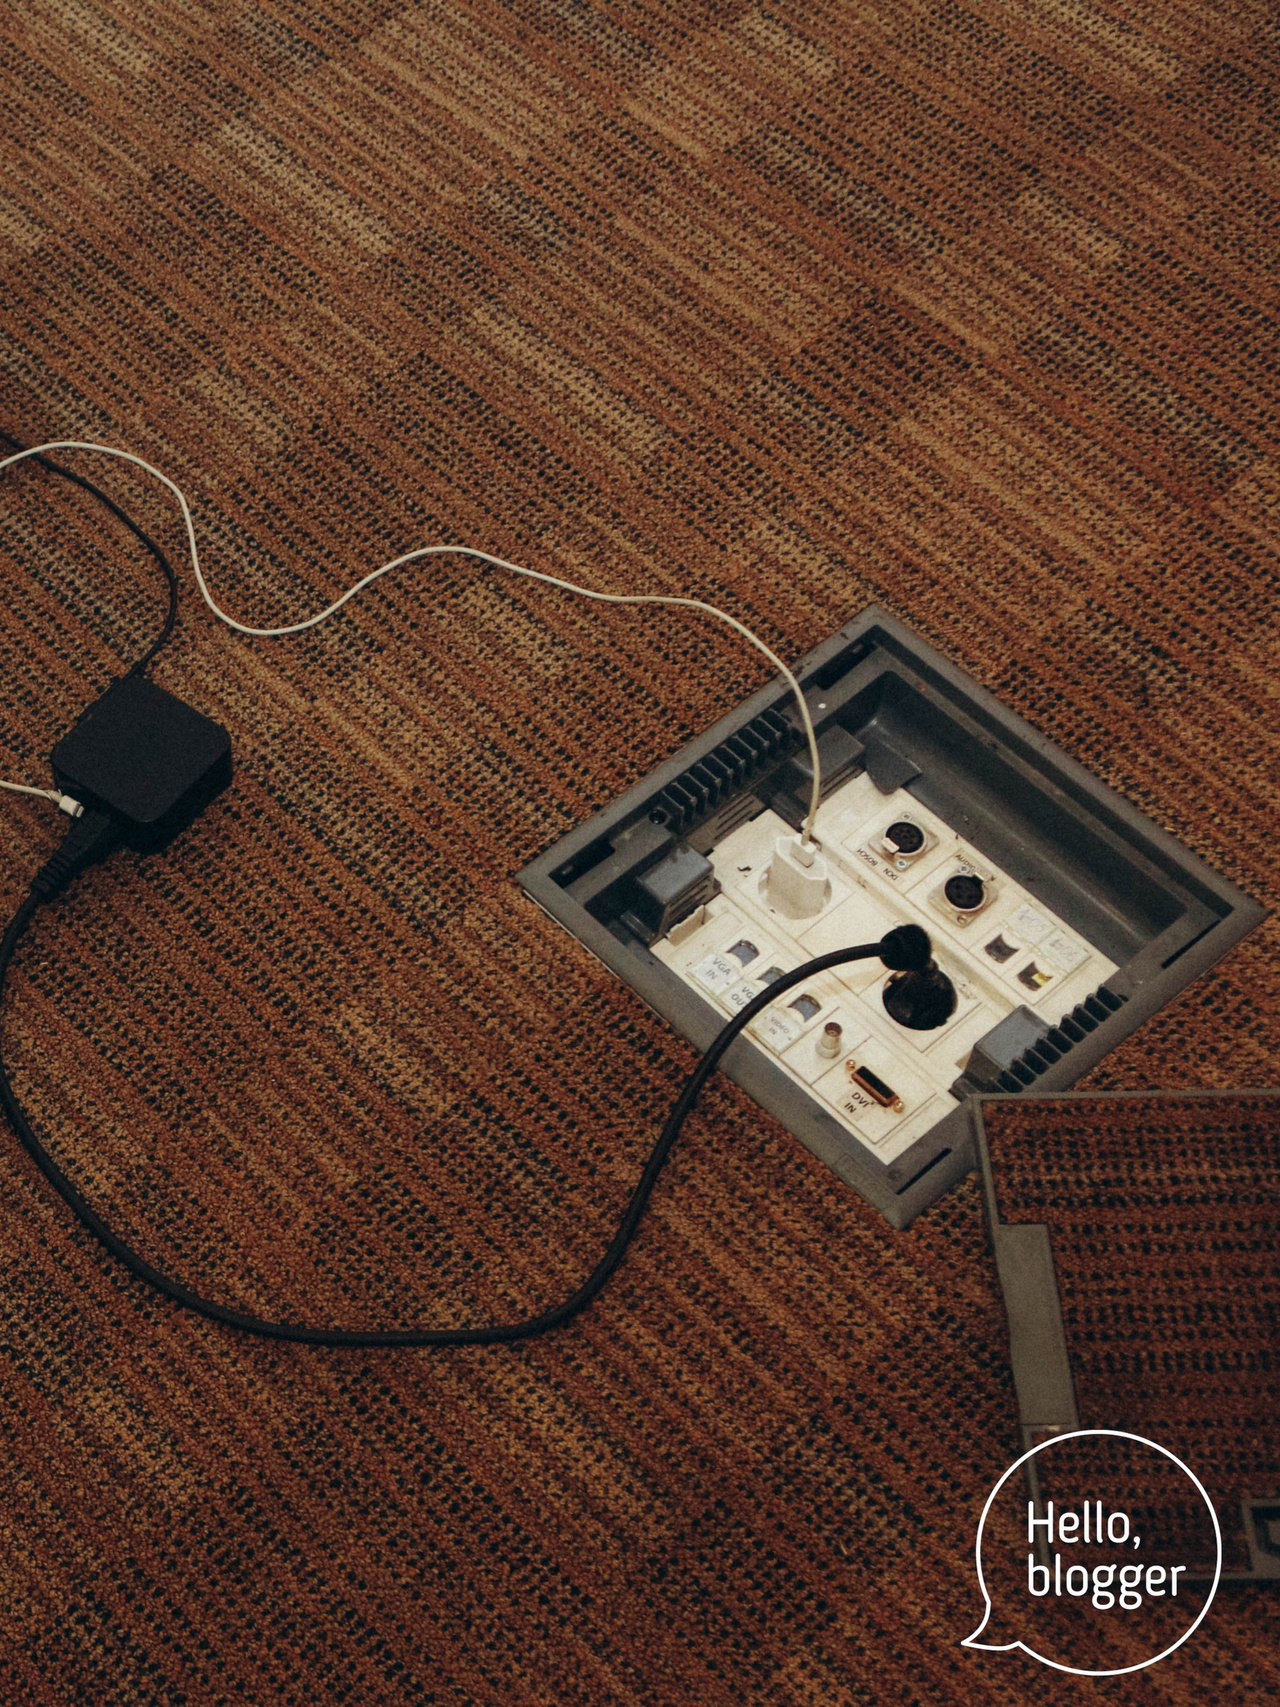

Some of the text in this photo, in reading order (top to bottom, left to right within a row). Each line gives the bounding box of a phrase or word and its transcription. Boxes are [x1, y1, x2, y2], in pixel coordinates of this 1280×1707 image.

[857, 848, 899, 881] DCN BOSCH
[713, 958, 731, 976] VGA
[706, 969, 718, 980] IN
[742, 986, 755, 999] VG
[731, 993, 746, 1006] OU
[851, 1092, 870, 1108] DVI
[844, 1102, 857, 1114] IN
